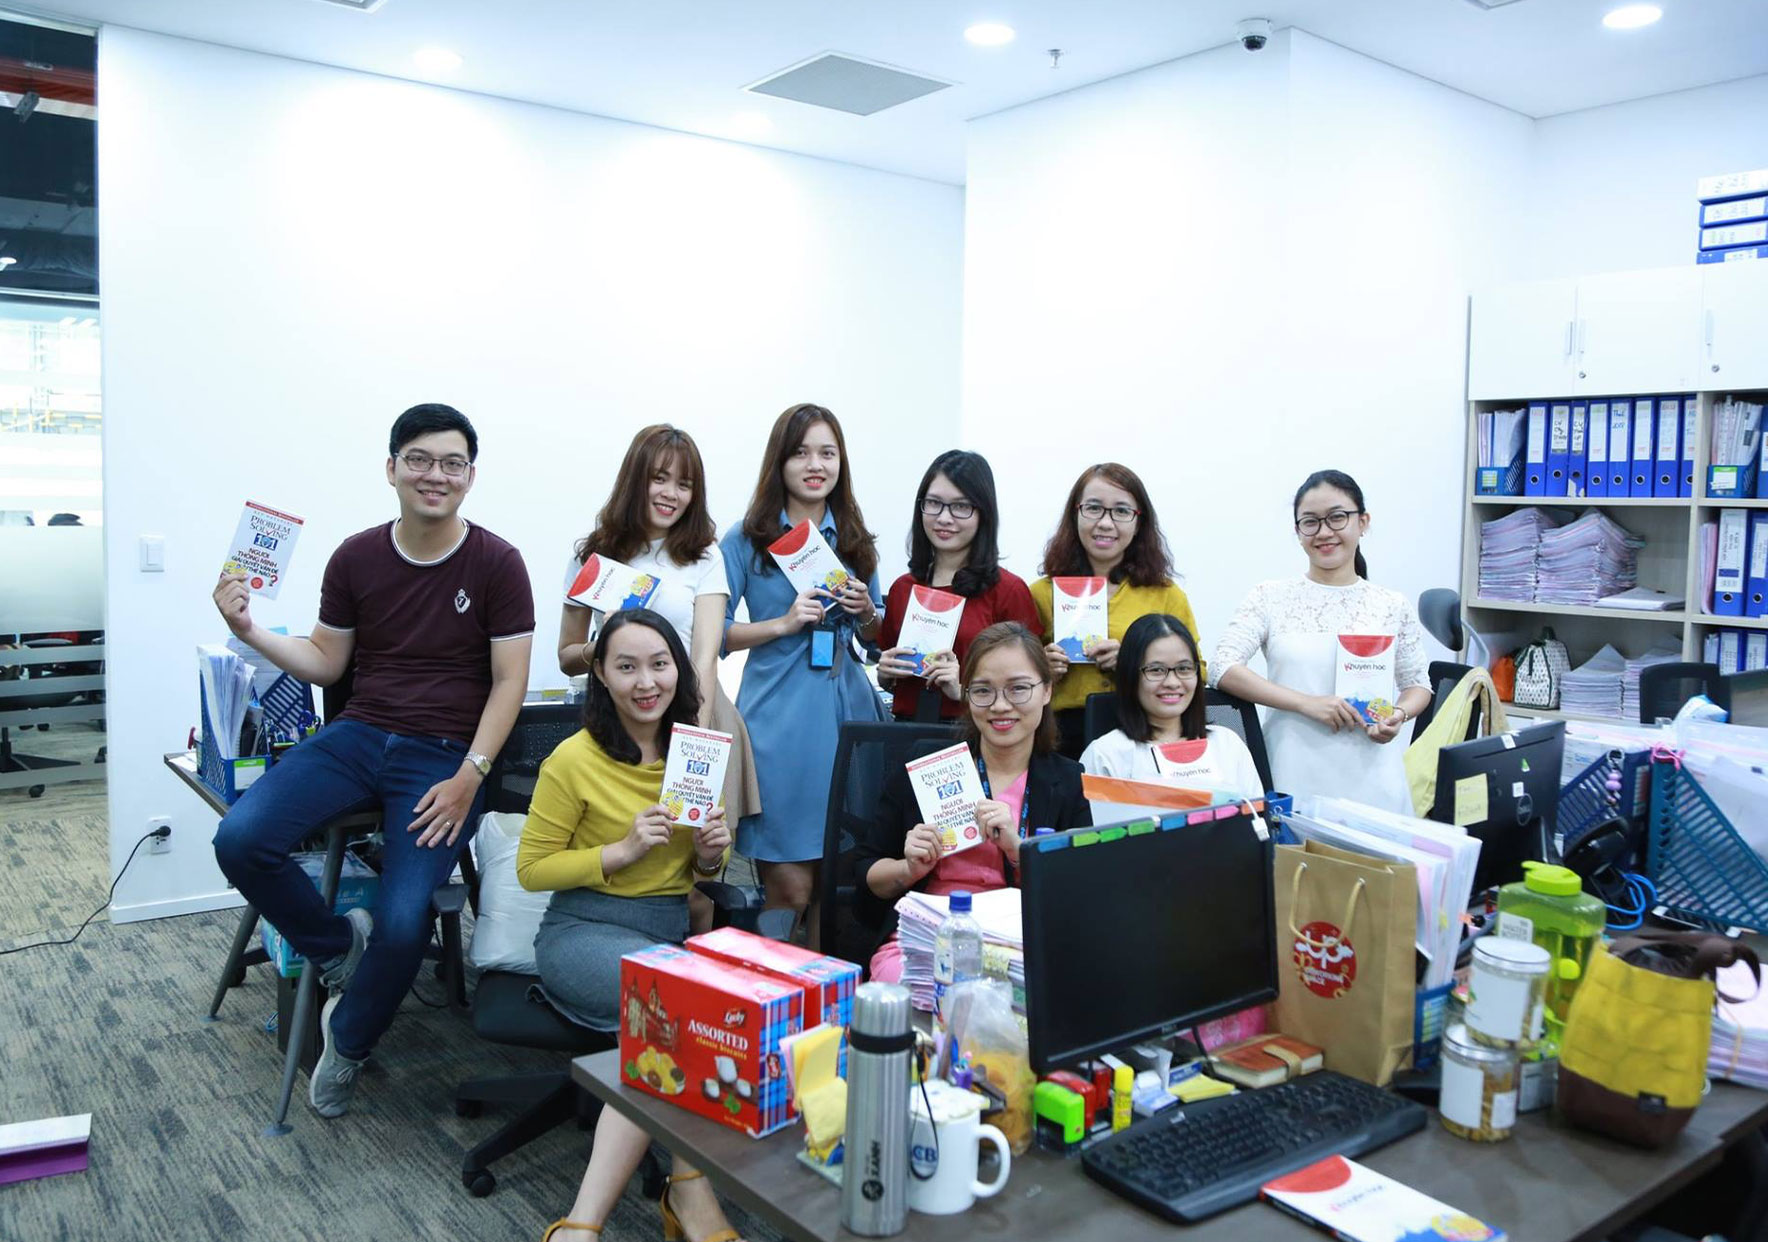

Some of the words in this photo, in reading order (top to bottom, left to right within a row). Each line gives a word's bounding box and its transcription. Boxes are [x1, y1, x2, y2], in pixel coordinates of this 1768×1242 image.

[249, 523, 288, 541] SOLVING
[250, 515, 291, 534] PROBLEM
[680, 741, 720, 755] PROBLEM
[680, 749, 718, 763] SOLVING
[920, 762, 965, 782] PROBLEM
[924, 771, 967, 788] SOLVING
[688, 1019, 749, 1051] ASSORTED
